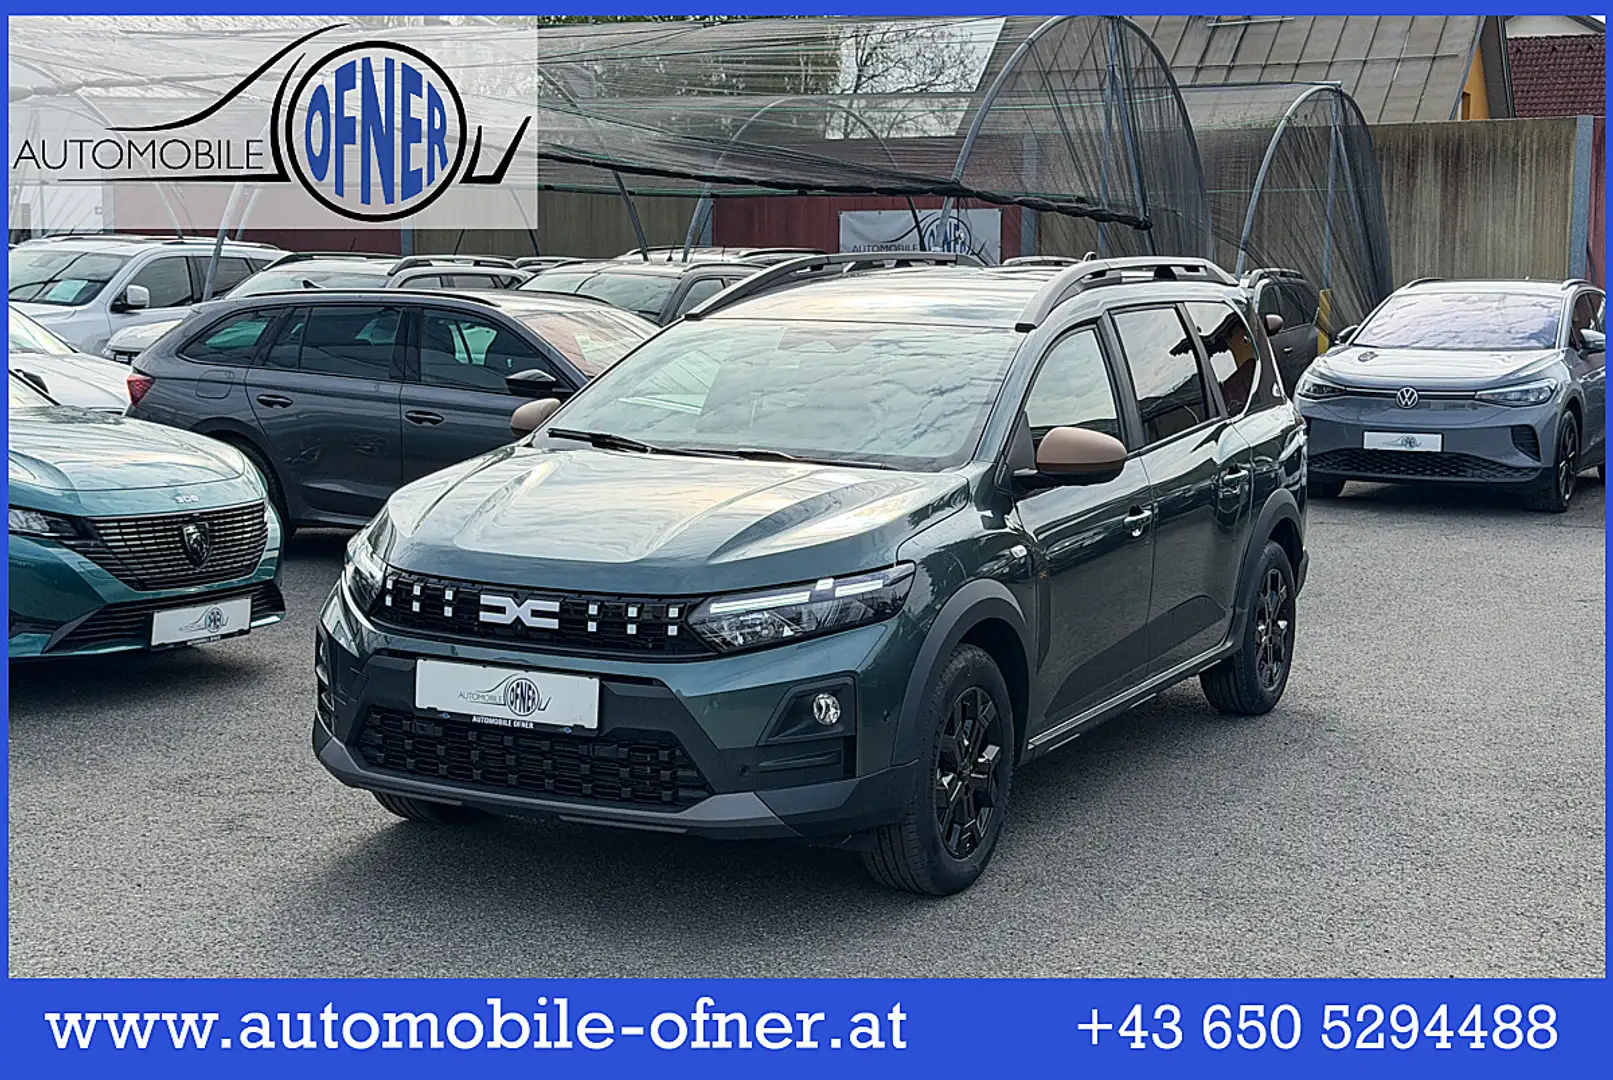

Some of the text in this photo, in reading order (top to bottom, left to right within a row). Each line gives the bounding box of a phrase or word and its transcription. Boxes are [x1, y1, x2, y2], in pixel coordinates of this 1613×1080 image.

[458, 691, 504, 703] AUTOMOBILE
[510, 681, 536, 713] OFNER
[472, 715, 512, 728] AUTOMOBILE
